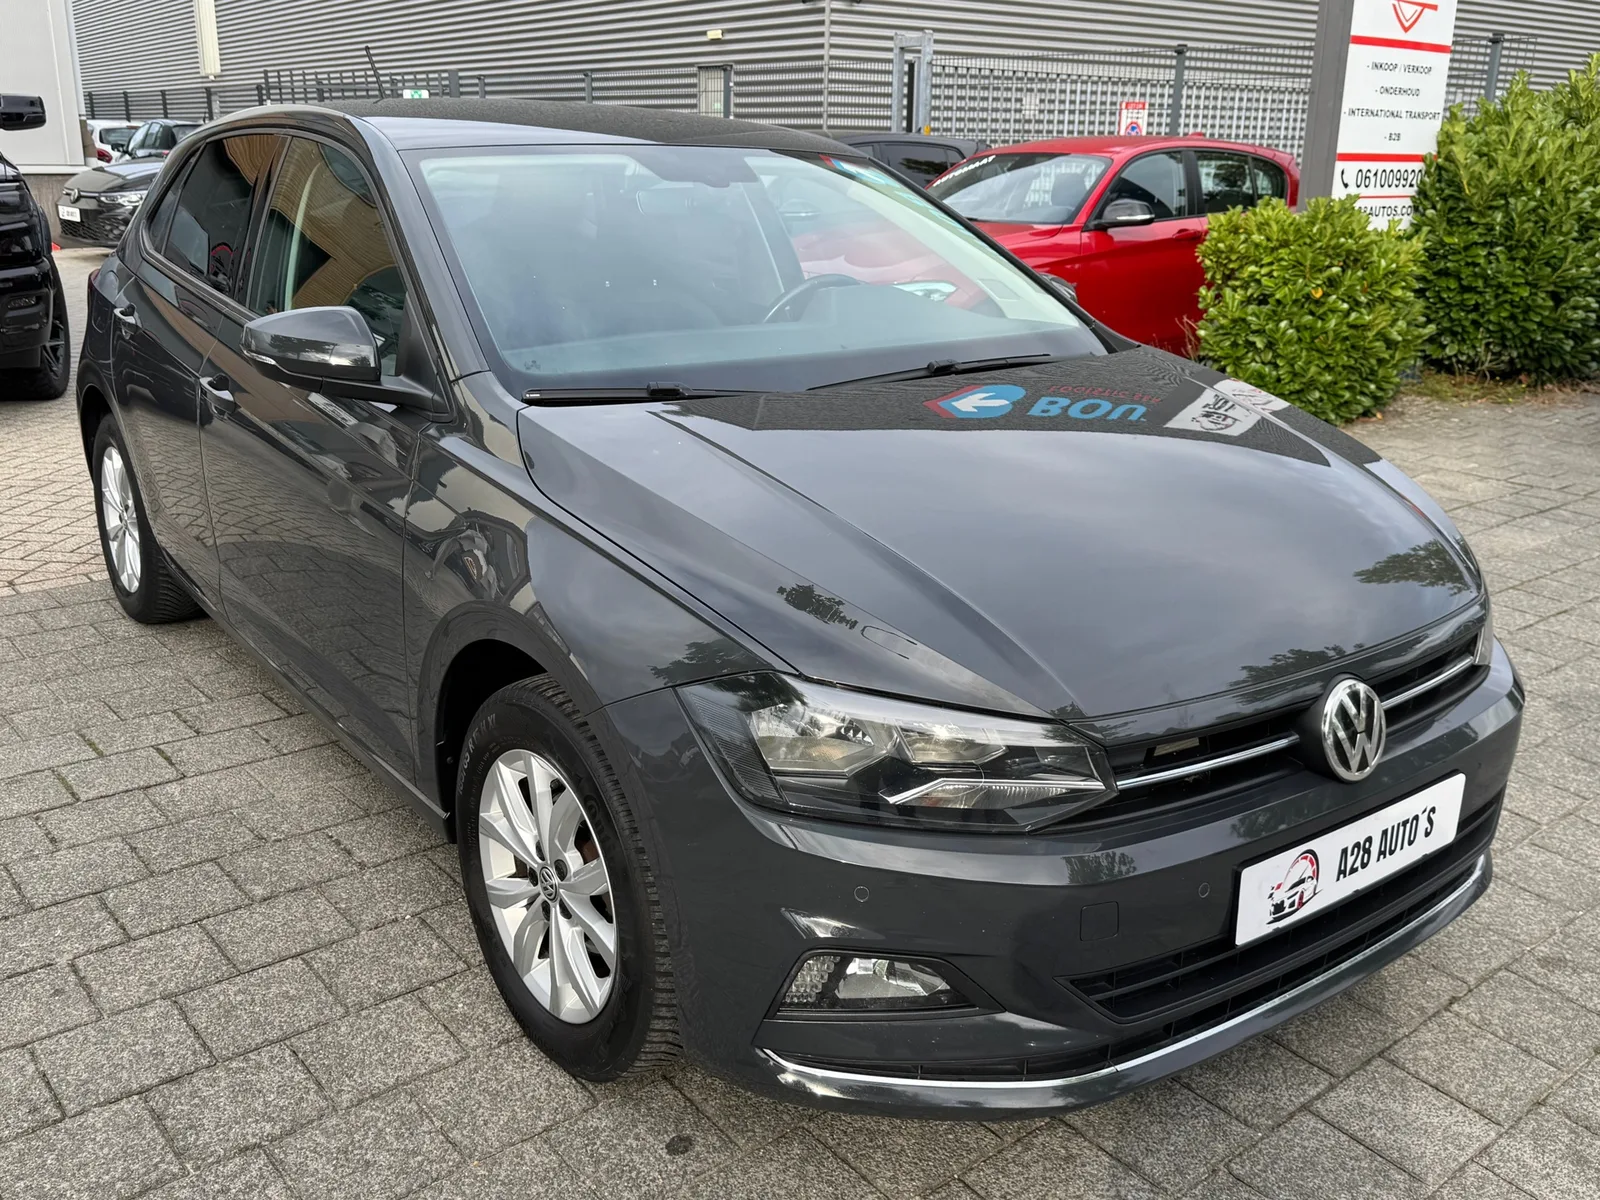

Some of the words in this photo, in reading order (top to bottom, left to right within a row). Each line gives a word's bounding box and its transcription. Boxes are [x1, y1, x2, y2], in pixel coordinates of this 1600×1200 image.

[1371, 61, 1398, 72] INKOOP
[1403, 64, 1432, 75] VERKOOP
[1379, 85, 1420, 97] ONDERHOUD
[1348, 107, 1402, 119] INTERNATIONAL
[1405, 110, 1441, 121] TRANSPORT
[1388, 132, 1401, 141] B2B
[1355, 168, 1424, 189] 061009920
[1335, 834, 1373, 883] A28
